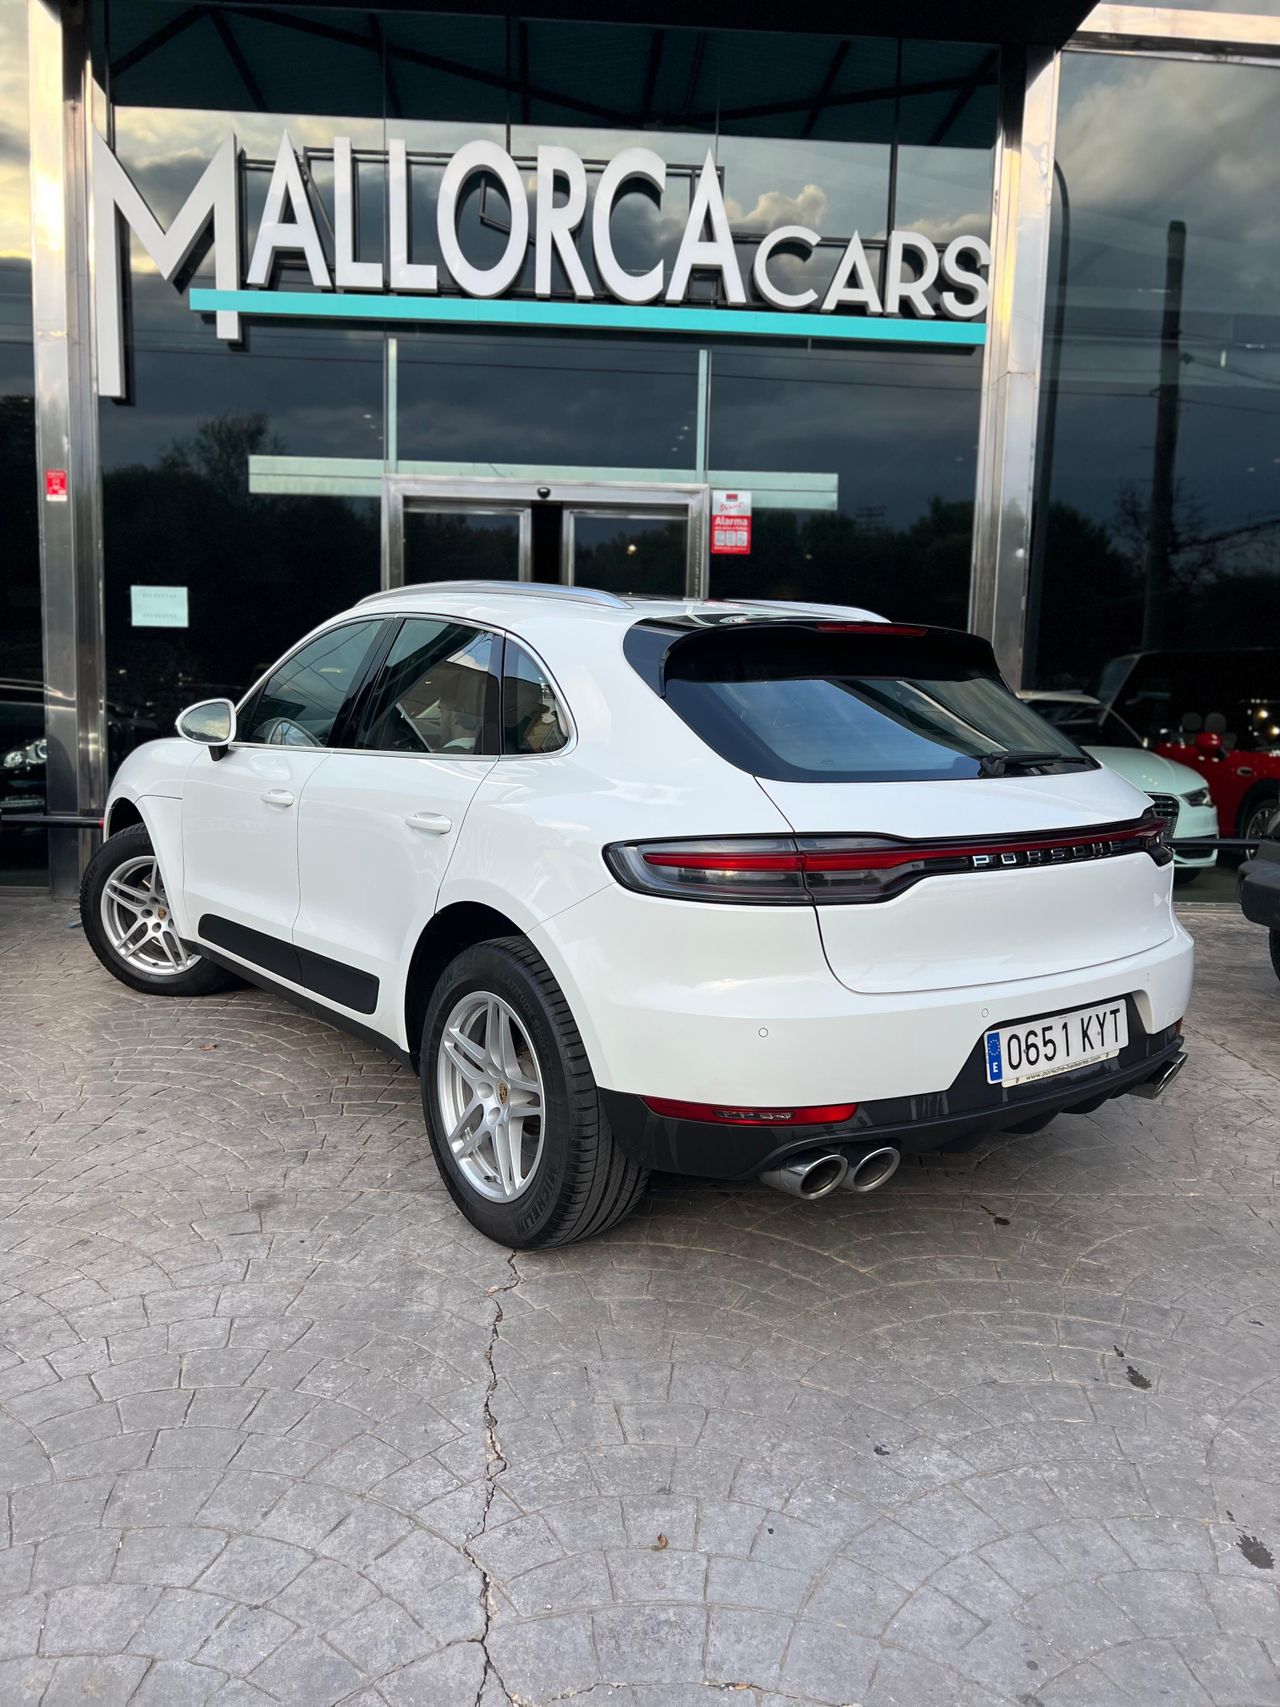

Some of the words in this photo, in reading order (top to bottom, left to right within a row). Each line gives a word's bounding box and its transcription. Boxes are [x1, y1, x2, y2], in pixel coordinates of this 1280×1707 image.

[91, 124, 748, 398] MALLORCA
[752, 225, 990, 321] CARS
[715, 515, 748, 526] Alarma
[972, 841, 1121, 868] PORSCHE
[1007, 1021, 1071, 1070] 0651
[1080, 1007, 1121, 1053] KYT
[992, 1062, 999, 1073] E
